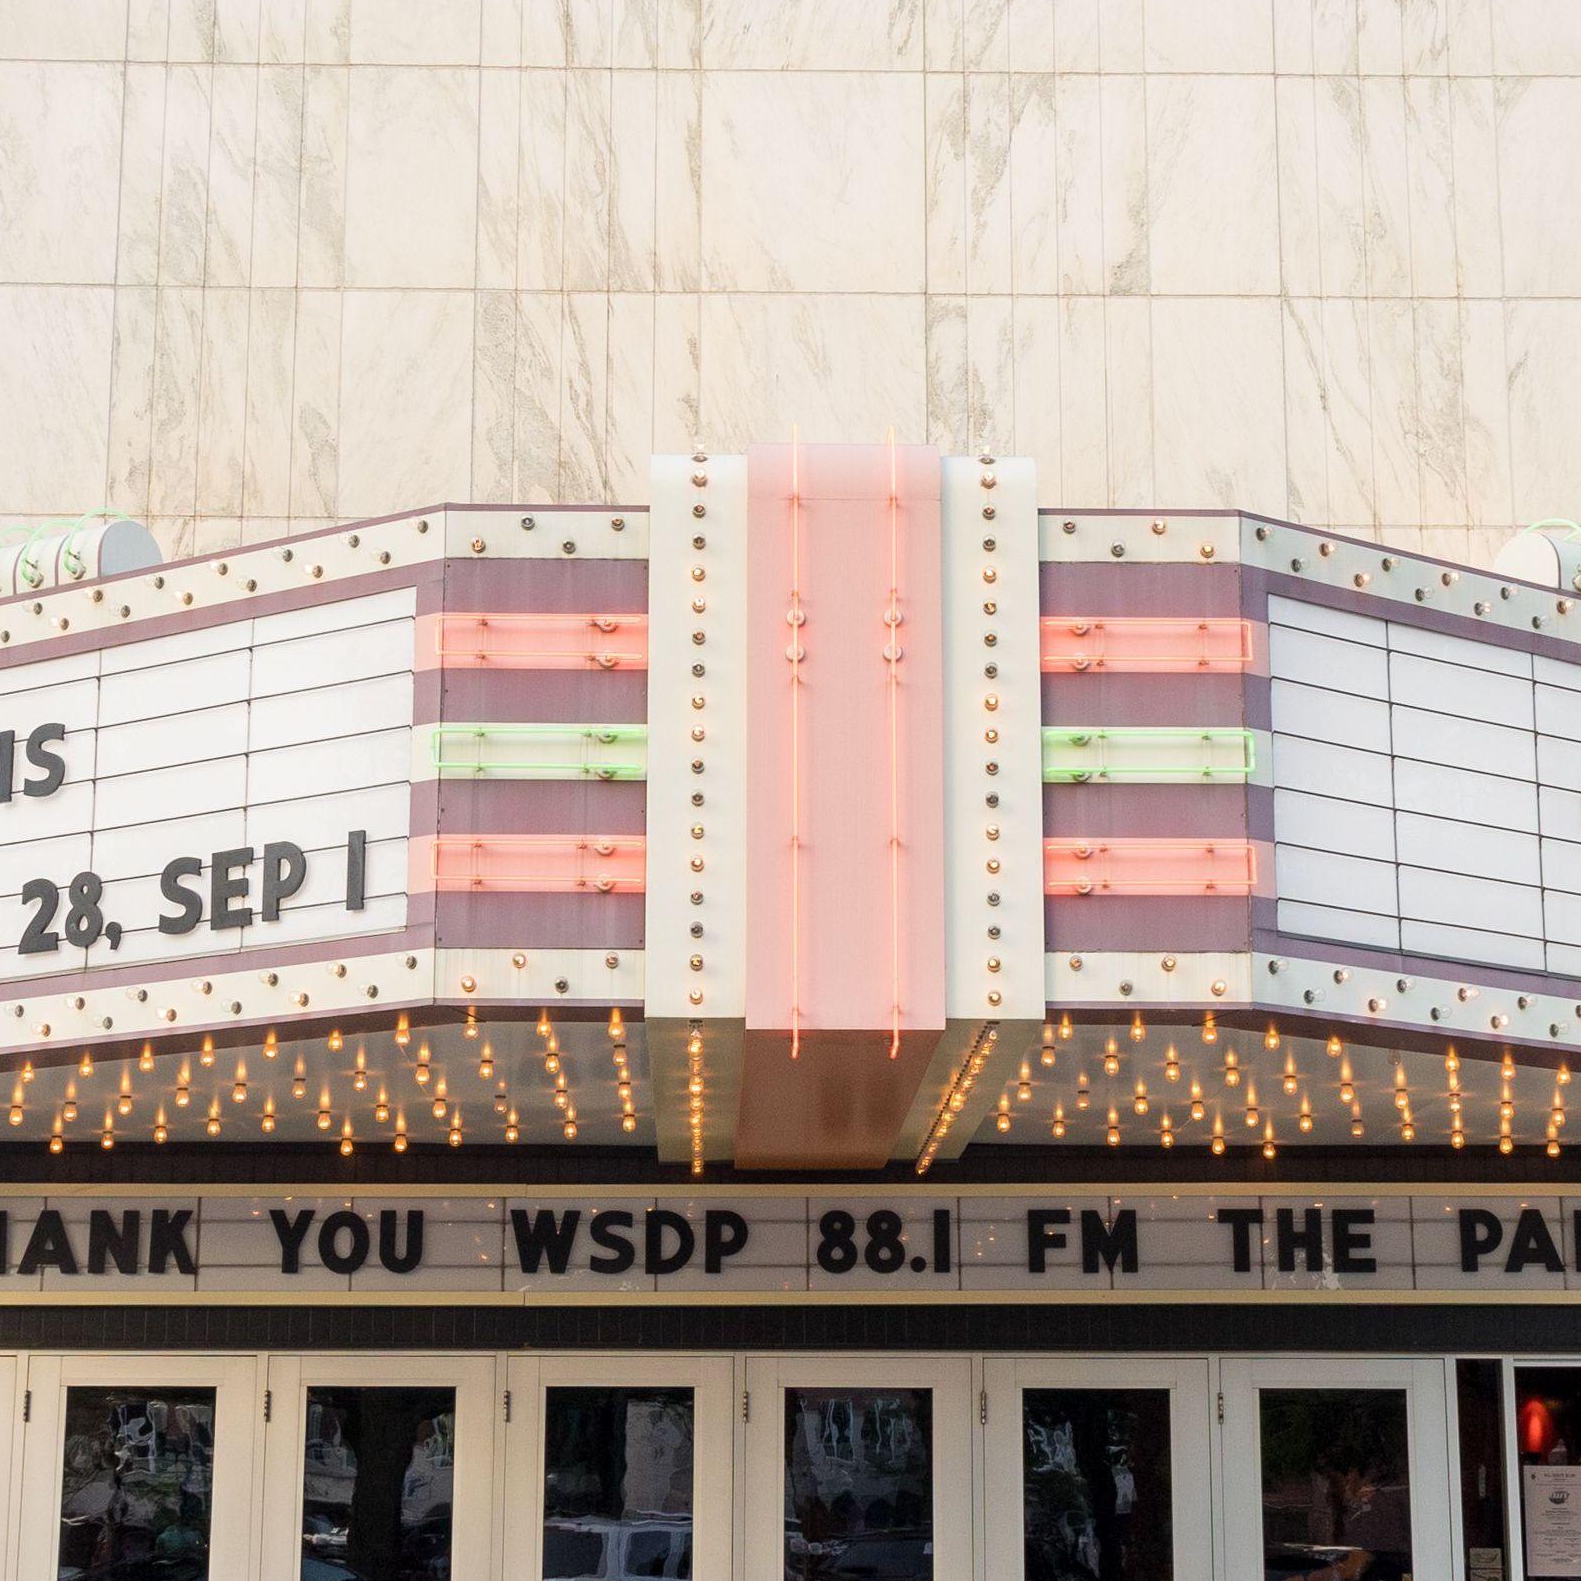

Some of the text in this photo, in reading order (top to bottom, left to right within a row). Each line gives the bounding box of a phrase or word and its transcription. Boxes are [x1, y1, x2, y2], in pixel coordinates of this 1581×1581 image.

[17, 871, 123, 955] 28,
[159, 840, 308, 936] SEP
[269, 1209, 425, 1276] YOU
[510, 1209, 751, 1276] WSDP
[816, 1209, 952, 1276] 88.1
[1027, 1209, 1140, 1276] FM
[1218, 1209, 1378, 1276] THE
